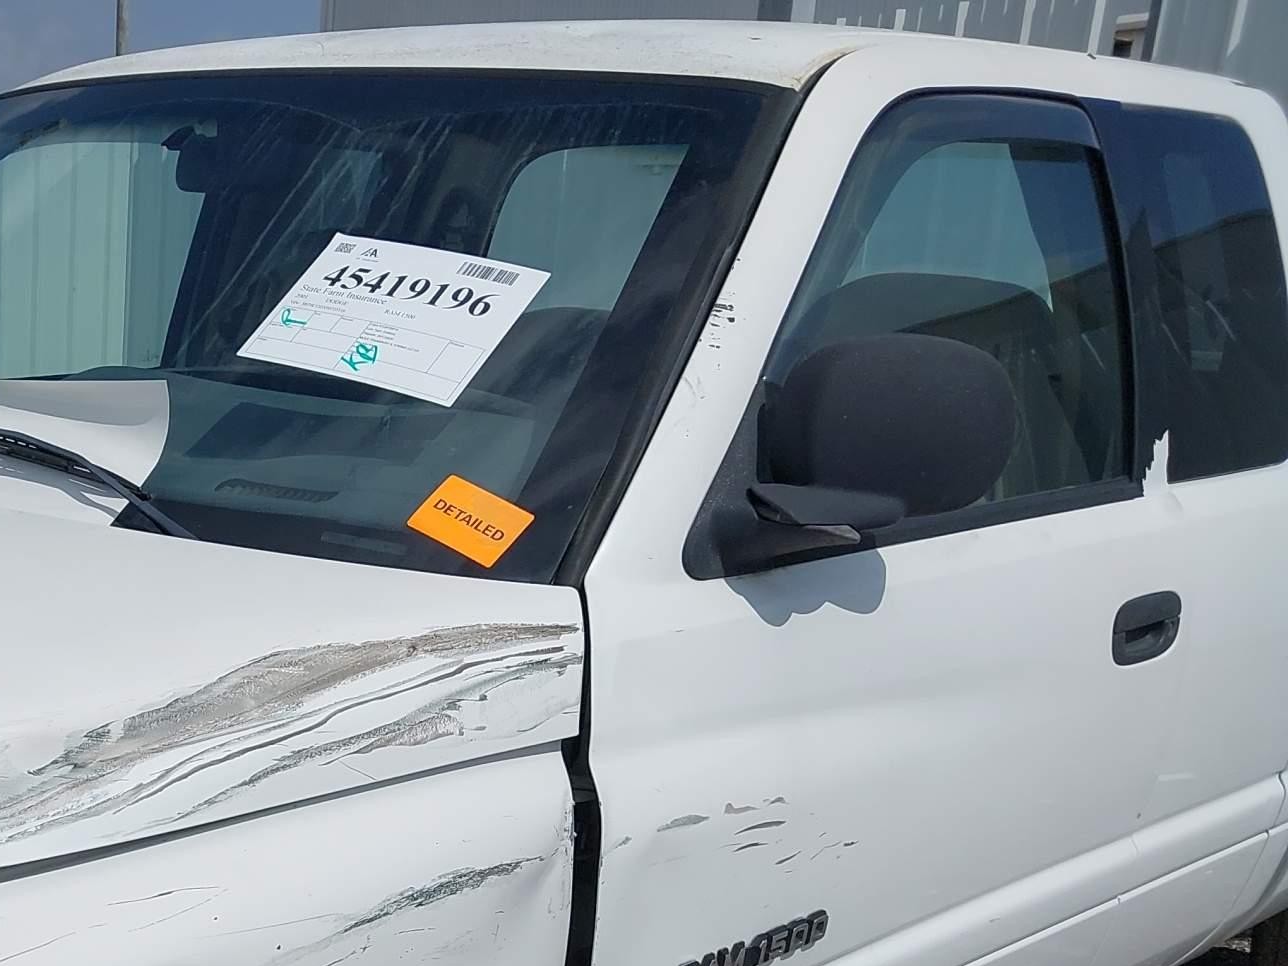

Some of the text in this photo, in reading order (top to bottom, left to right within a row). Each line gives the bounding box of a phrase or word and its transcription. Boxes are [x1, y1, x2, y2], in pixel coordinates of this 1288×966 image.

[300, 284, 388, 305] State Farm Insurance
[323, 265, 501, 317] 45419196
[433, 498, 505, 542] DETAILED
